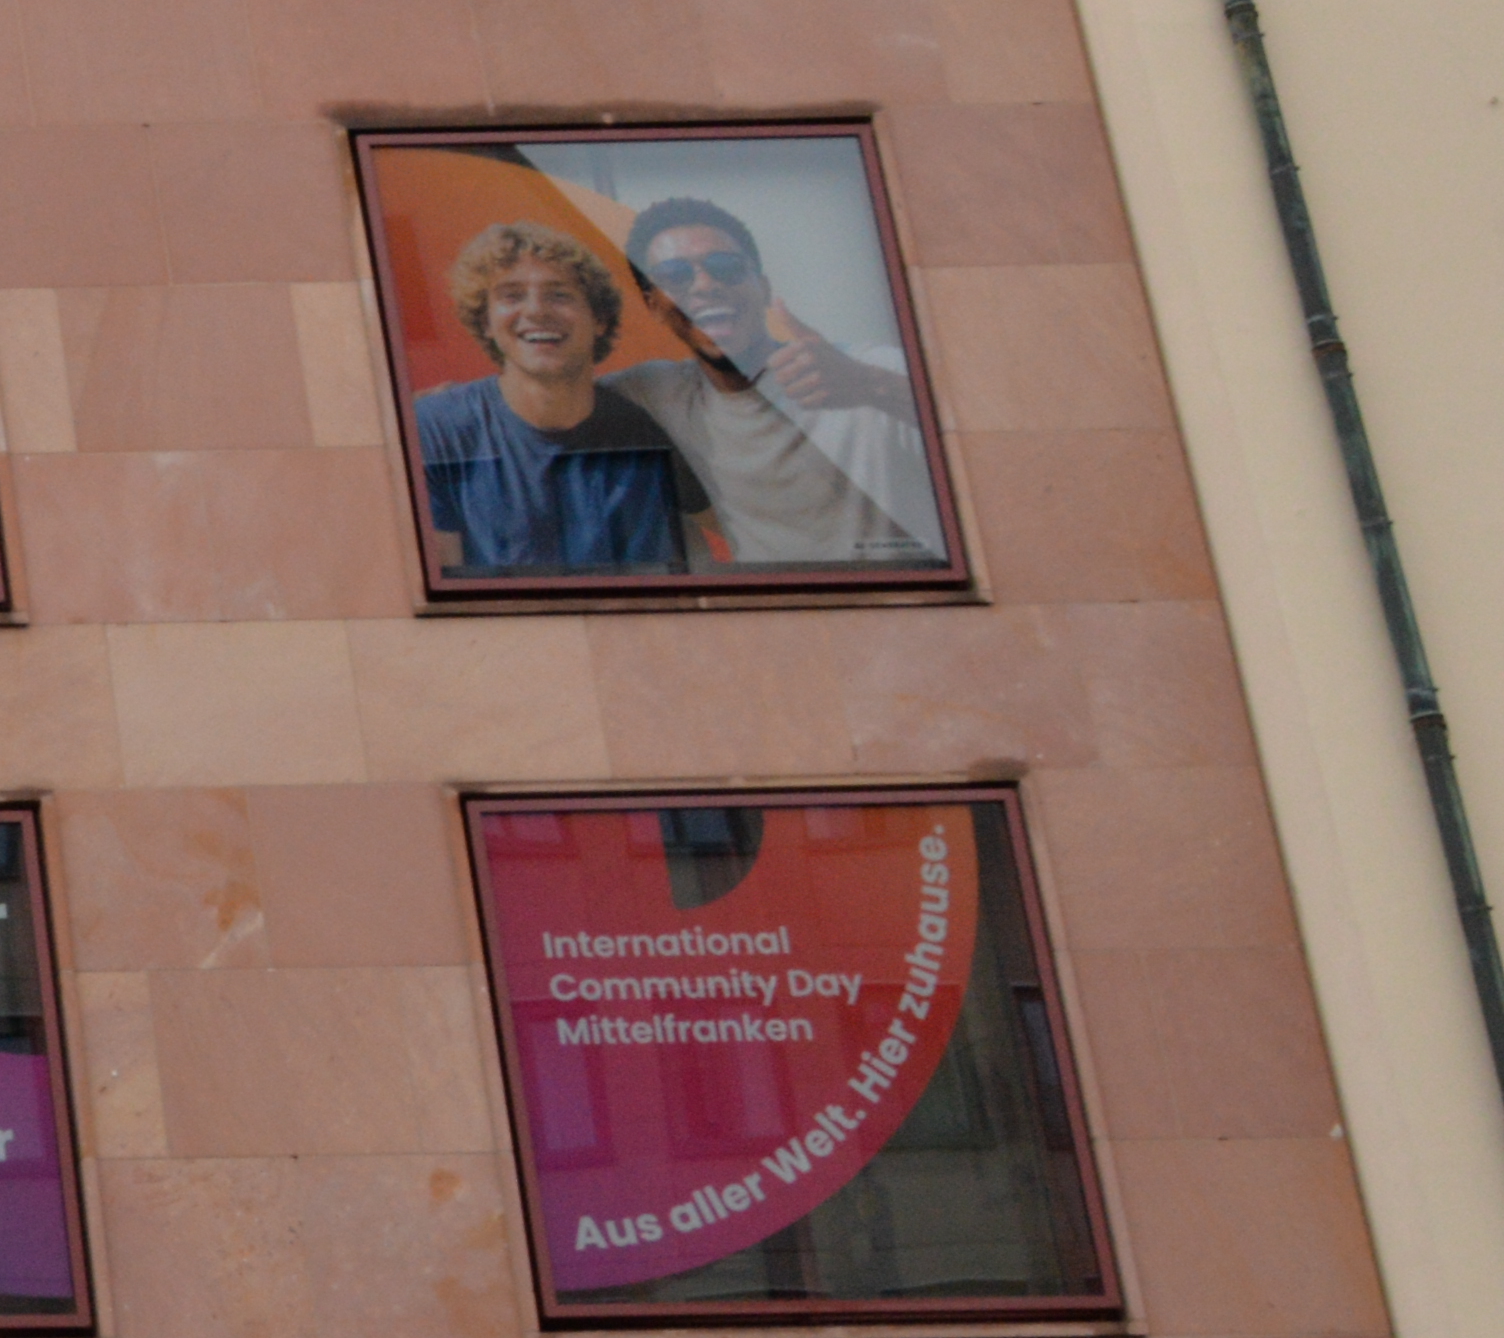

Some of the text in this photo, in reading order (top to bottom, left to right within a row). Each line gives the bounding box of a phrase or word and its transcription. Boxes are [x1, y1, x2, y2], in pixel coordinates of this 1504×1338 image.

[543, 925, 789, 960] International
[549, 967, 863, 1007] Community Day
[557, 1012, 814, 1047] Mittelfranken
[574, 822, 951, 1253] Aus aller Welt. Hier zuhause.
